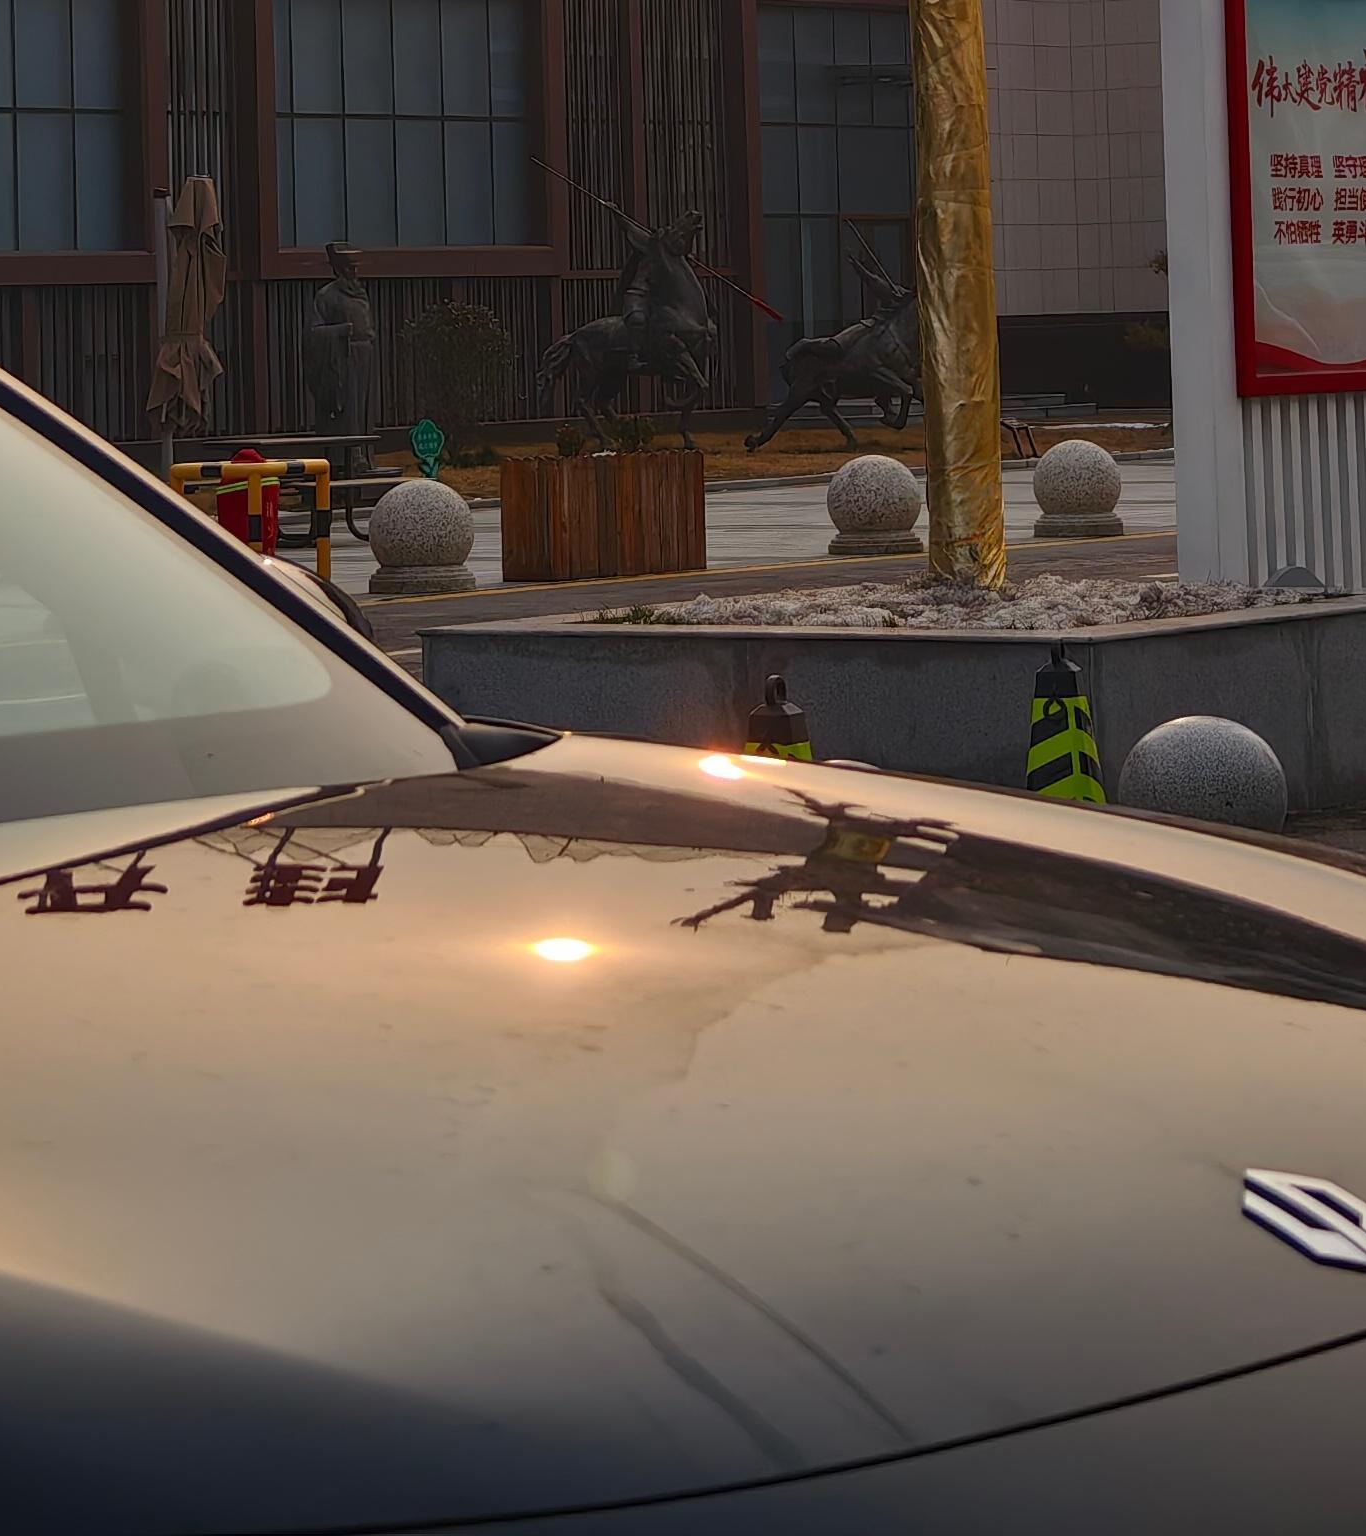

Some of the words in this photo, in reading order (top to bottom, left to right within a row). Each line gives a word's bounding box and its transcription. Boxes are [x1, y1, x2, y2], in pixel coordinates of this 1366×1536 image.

[1270, 154, 1323, 179] 坚持真理
[1272, 187, 1323, 212] 践行初心
[1274, 220, 1322, 245] 不怕牺牲
